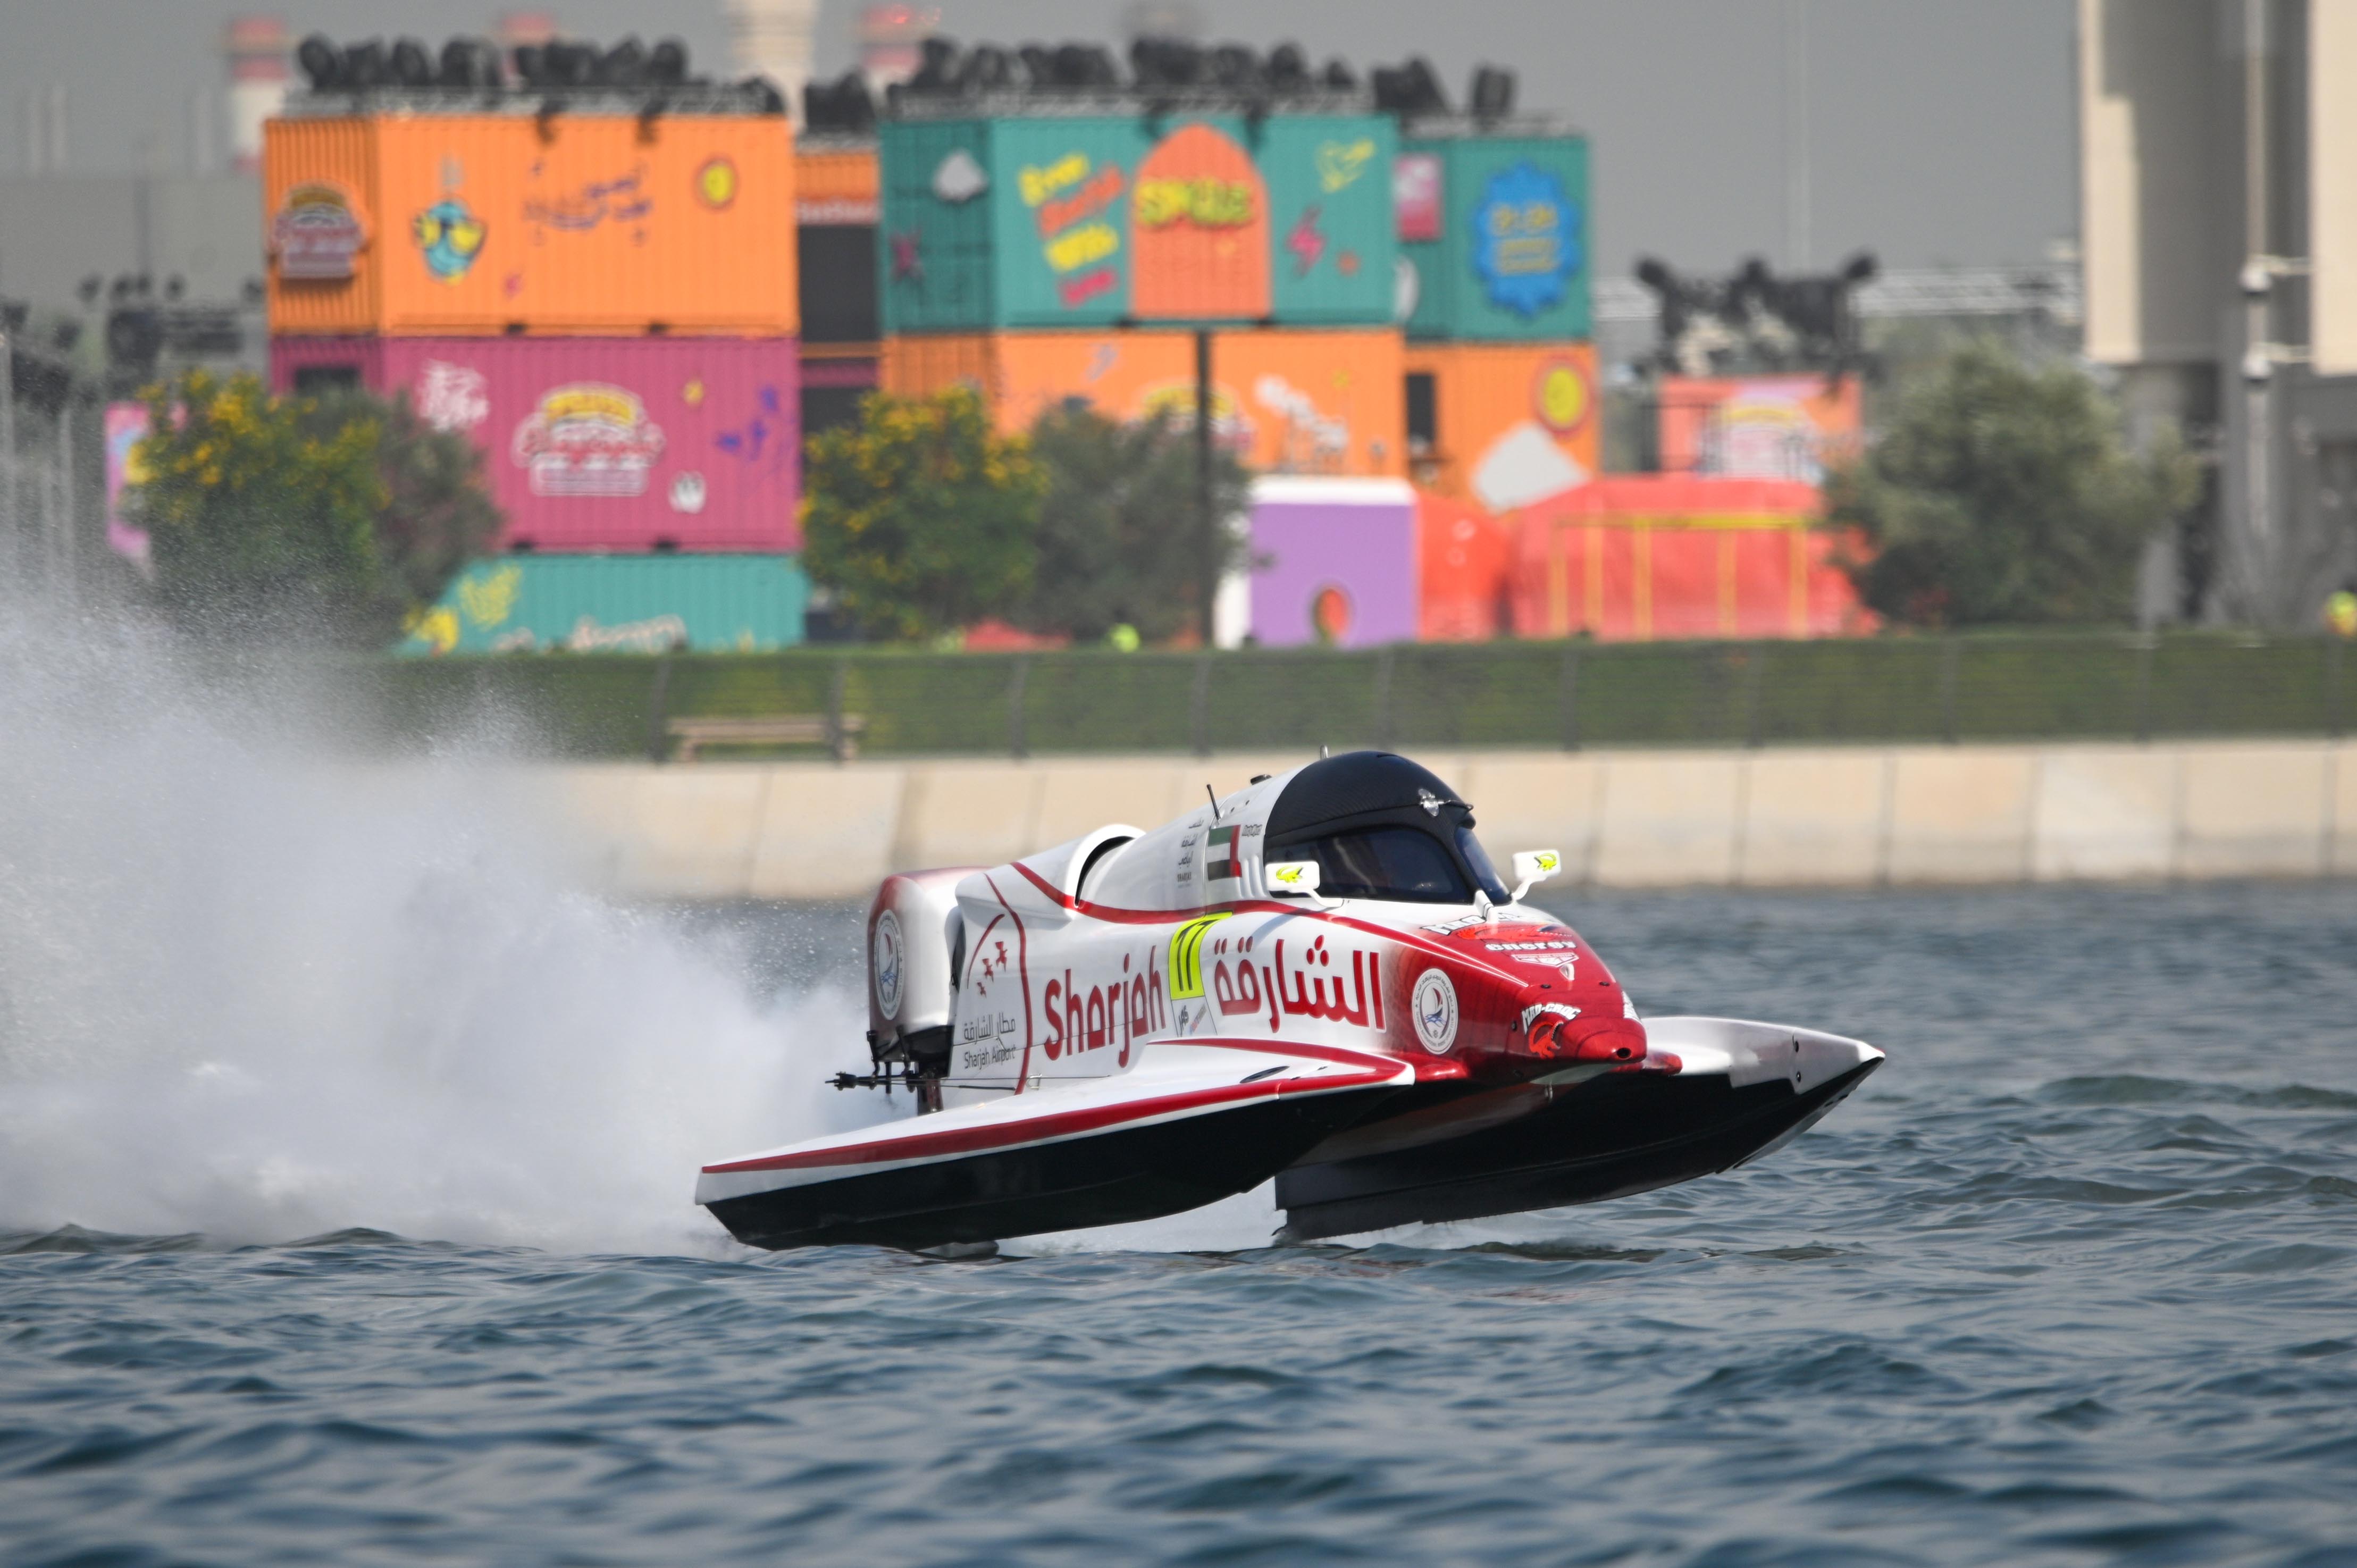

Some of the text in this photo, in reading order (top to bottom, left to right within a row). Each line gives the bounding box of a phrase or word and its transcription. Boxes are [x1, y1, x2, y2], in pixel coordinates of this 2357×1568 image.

[1176, 919, 1220, 992] 11
[1484, 941, 1577, 951] energy
[1214, 934, 1386, 1034] الشارقة
[1044, 944, 1167, 1069] Sharjah
[1521, 1001, 1582, 1035] MAD-CROC
[964, 1012, 1016, 1045] مطار الشارقة
[964, 1044, 1017, 1070] Sharjah Airport
